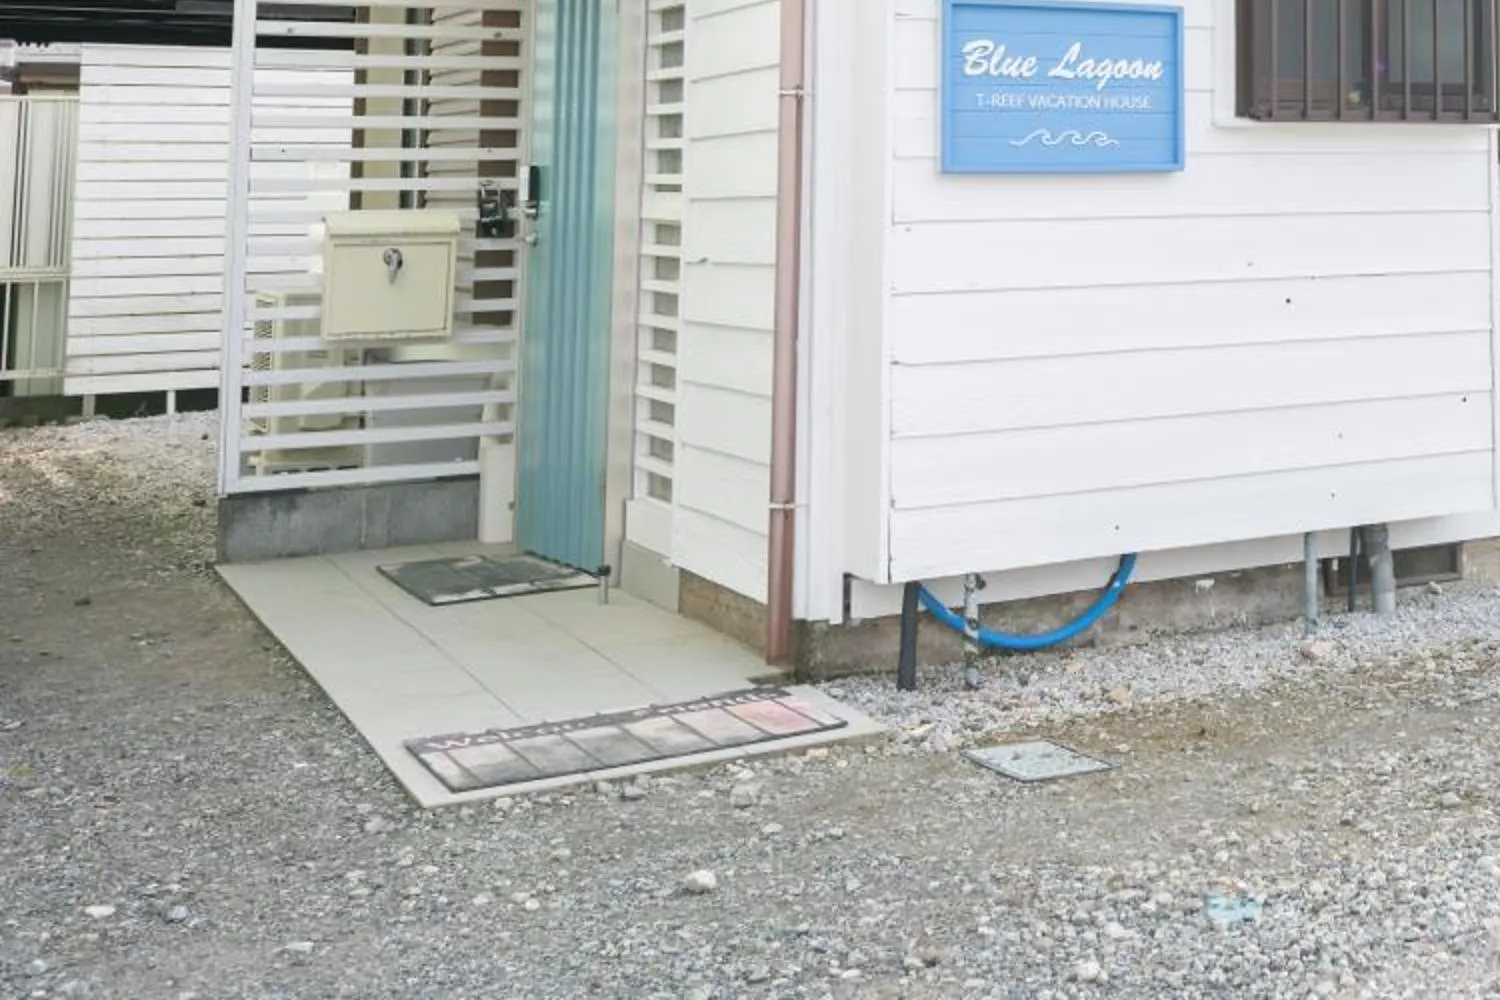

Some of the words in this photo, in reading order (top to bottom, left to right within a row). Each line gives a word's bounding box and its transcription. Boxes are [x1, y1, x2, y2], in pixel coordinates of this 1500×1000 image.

[962, 40, 1037, 77] Blue
[1049, 42, 1163, 89] Lagoon
[1028, 93, 1100, 109] VACATION
[1103, 95, 1152, 109] HOUSE
